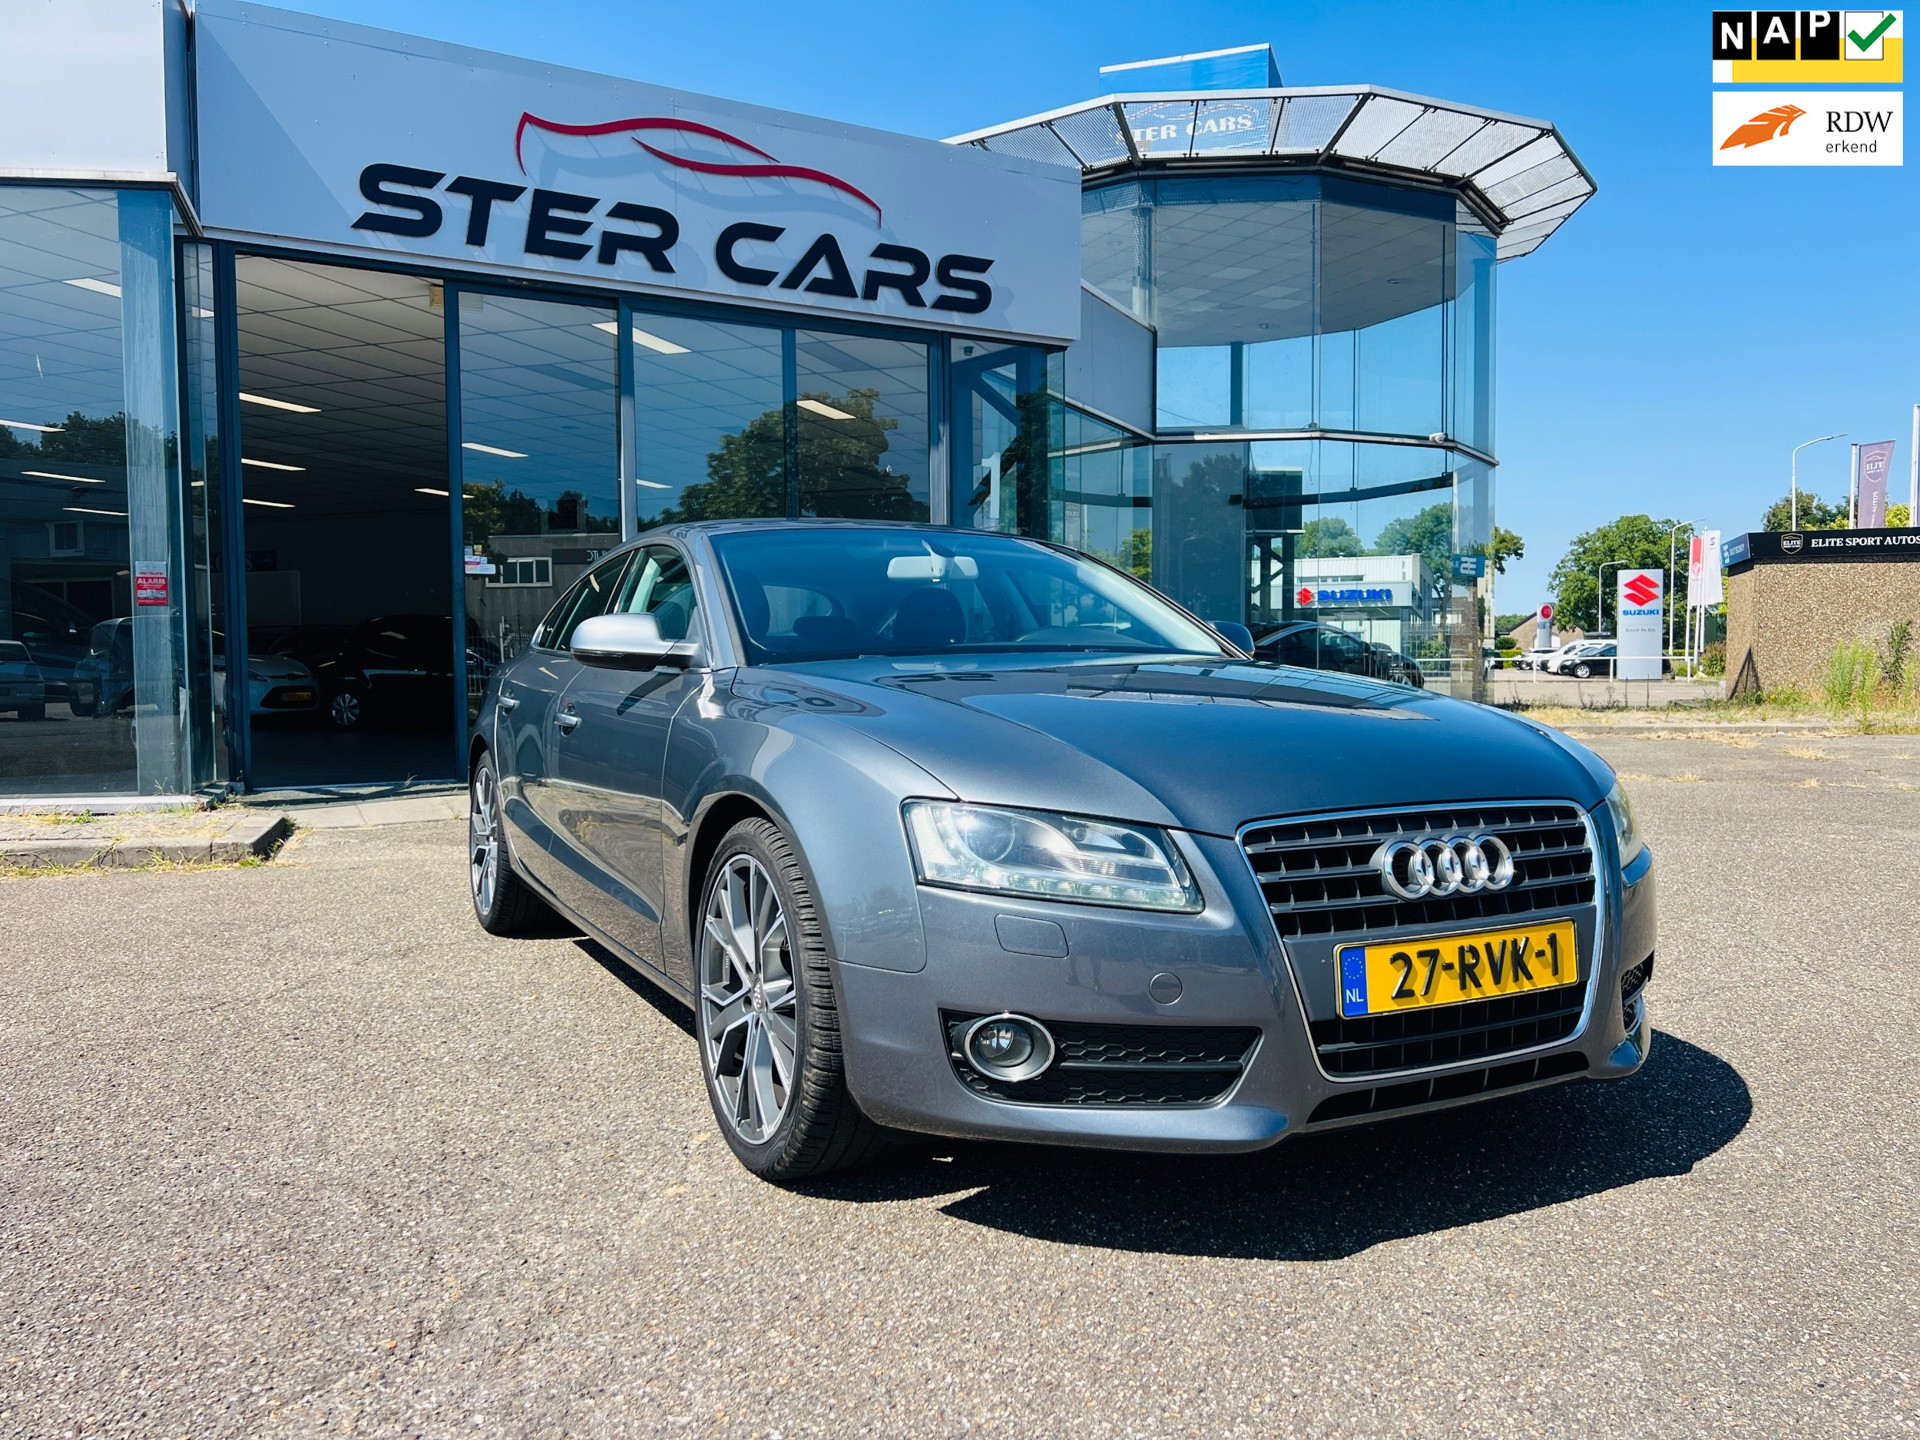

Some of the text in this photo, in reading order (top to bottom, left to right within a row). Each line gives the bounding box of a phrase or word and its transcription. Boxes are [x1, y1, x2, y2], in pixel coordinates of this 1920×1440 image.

[1116, 114, 1253, 145] TER CARS
[350, 162, 996, 315] STER CARS
[1811, 535, 1920, 548] ELITE SPORT AUTOS
[1317, 588, 1392, 603] SUZUKI
[1389, 932, 1559, 999] 27-RVK-1
[1345, 988, 1364, 1004] NL
